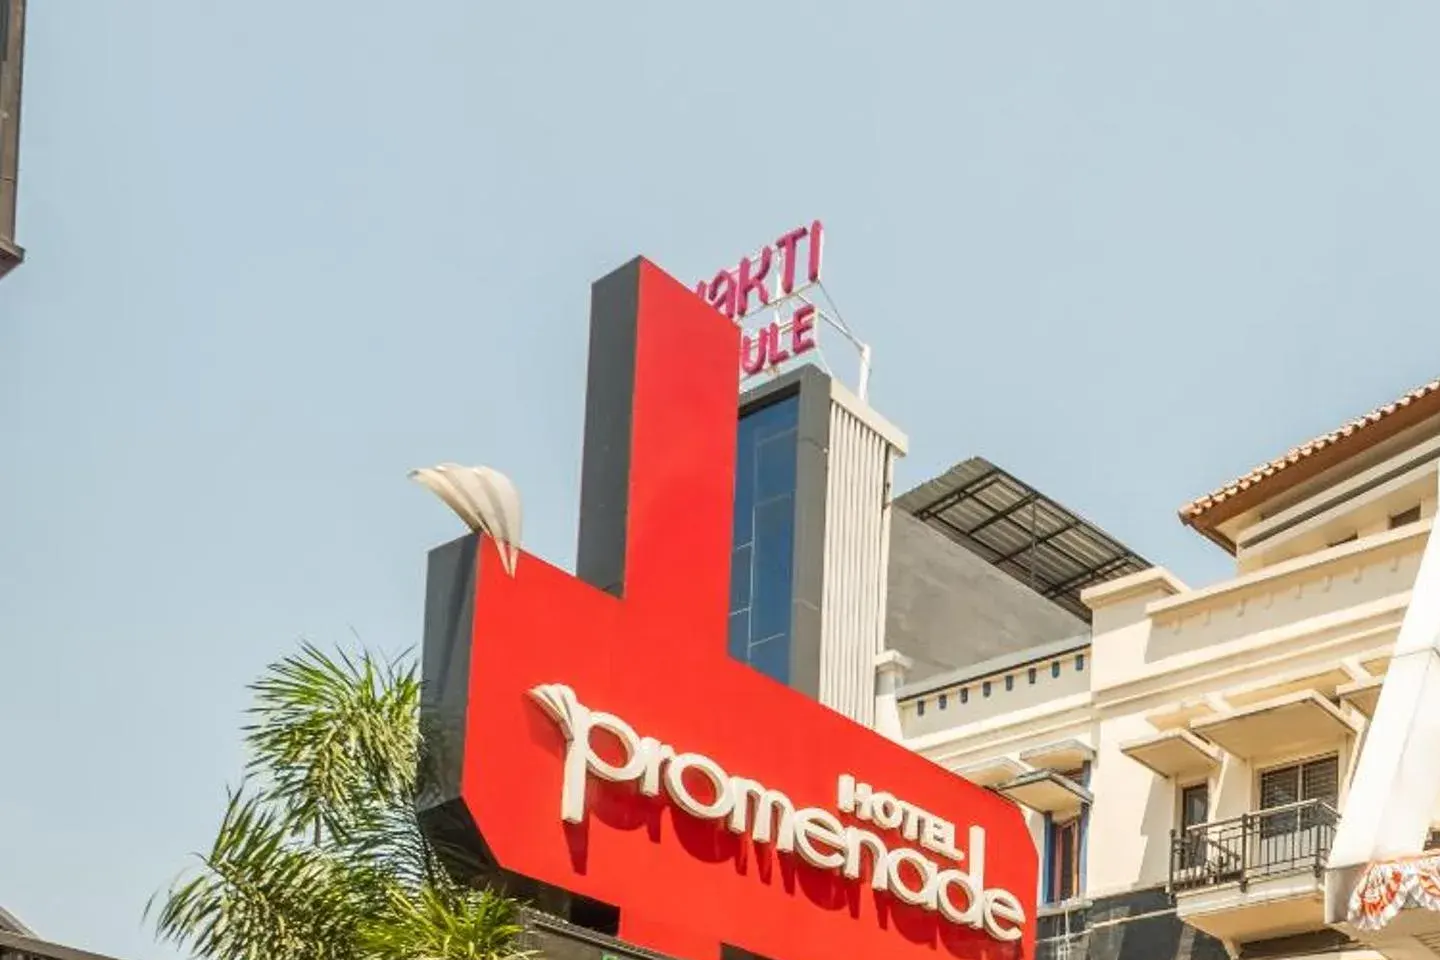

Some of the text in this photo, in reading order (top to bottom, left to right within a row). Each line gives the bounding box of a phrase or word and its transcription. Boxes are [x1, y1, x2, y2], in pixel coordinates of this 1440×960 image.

[742, 304, 815, 376] ULE
[528, 683, 1026, 941] promenade
[838, 774, 964, 861] HOTEL
